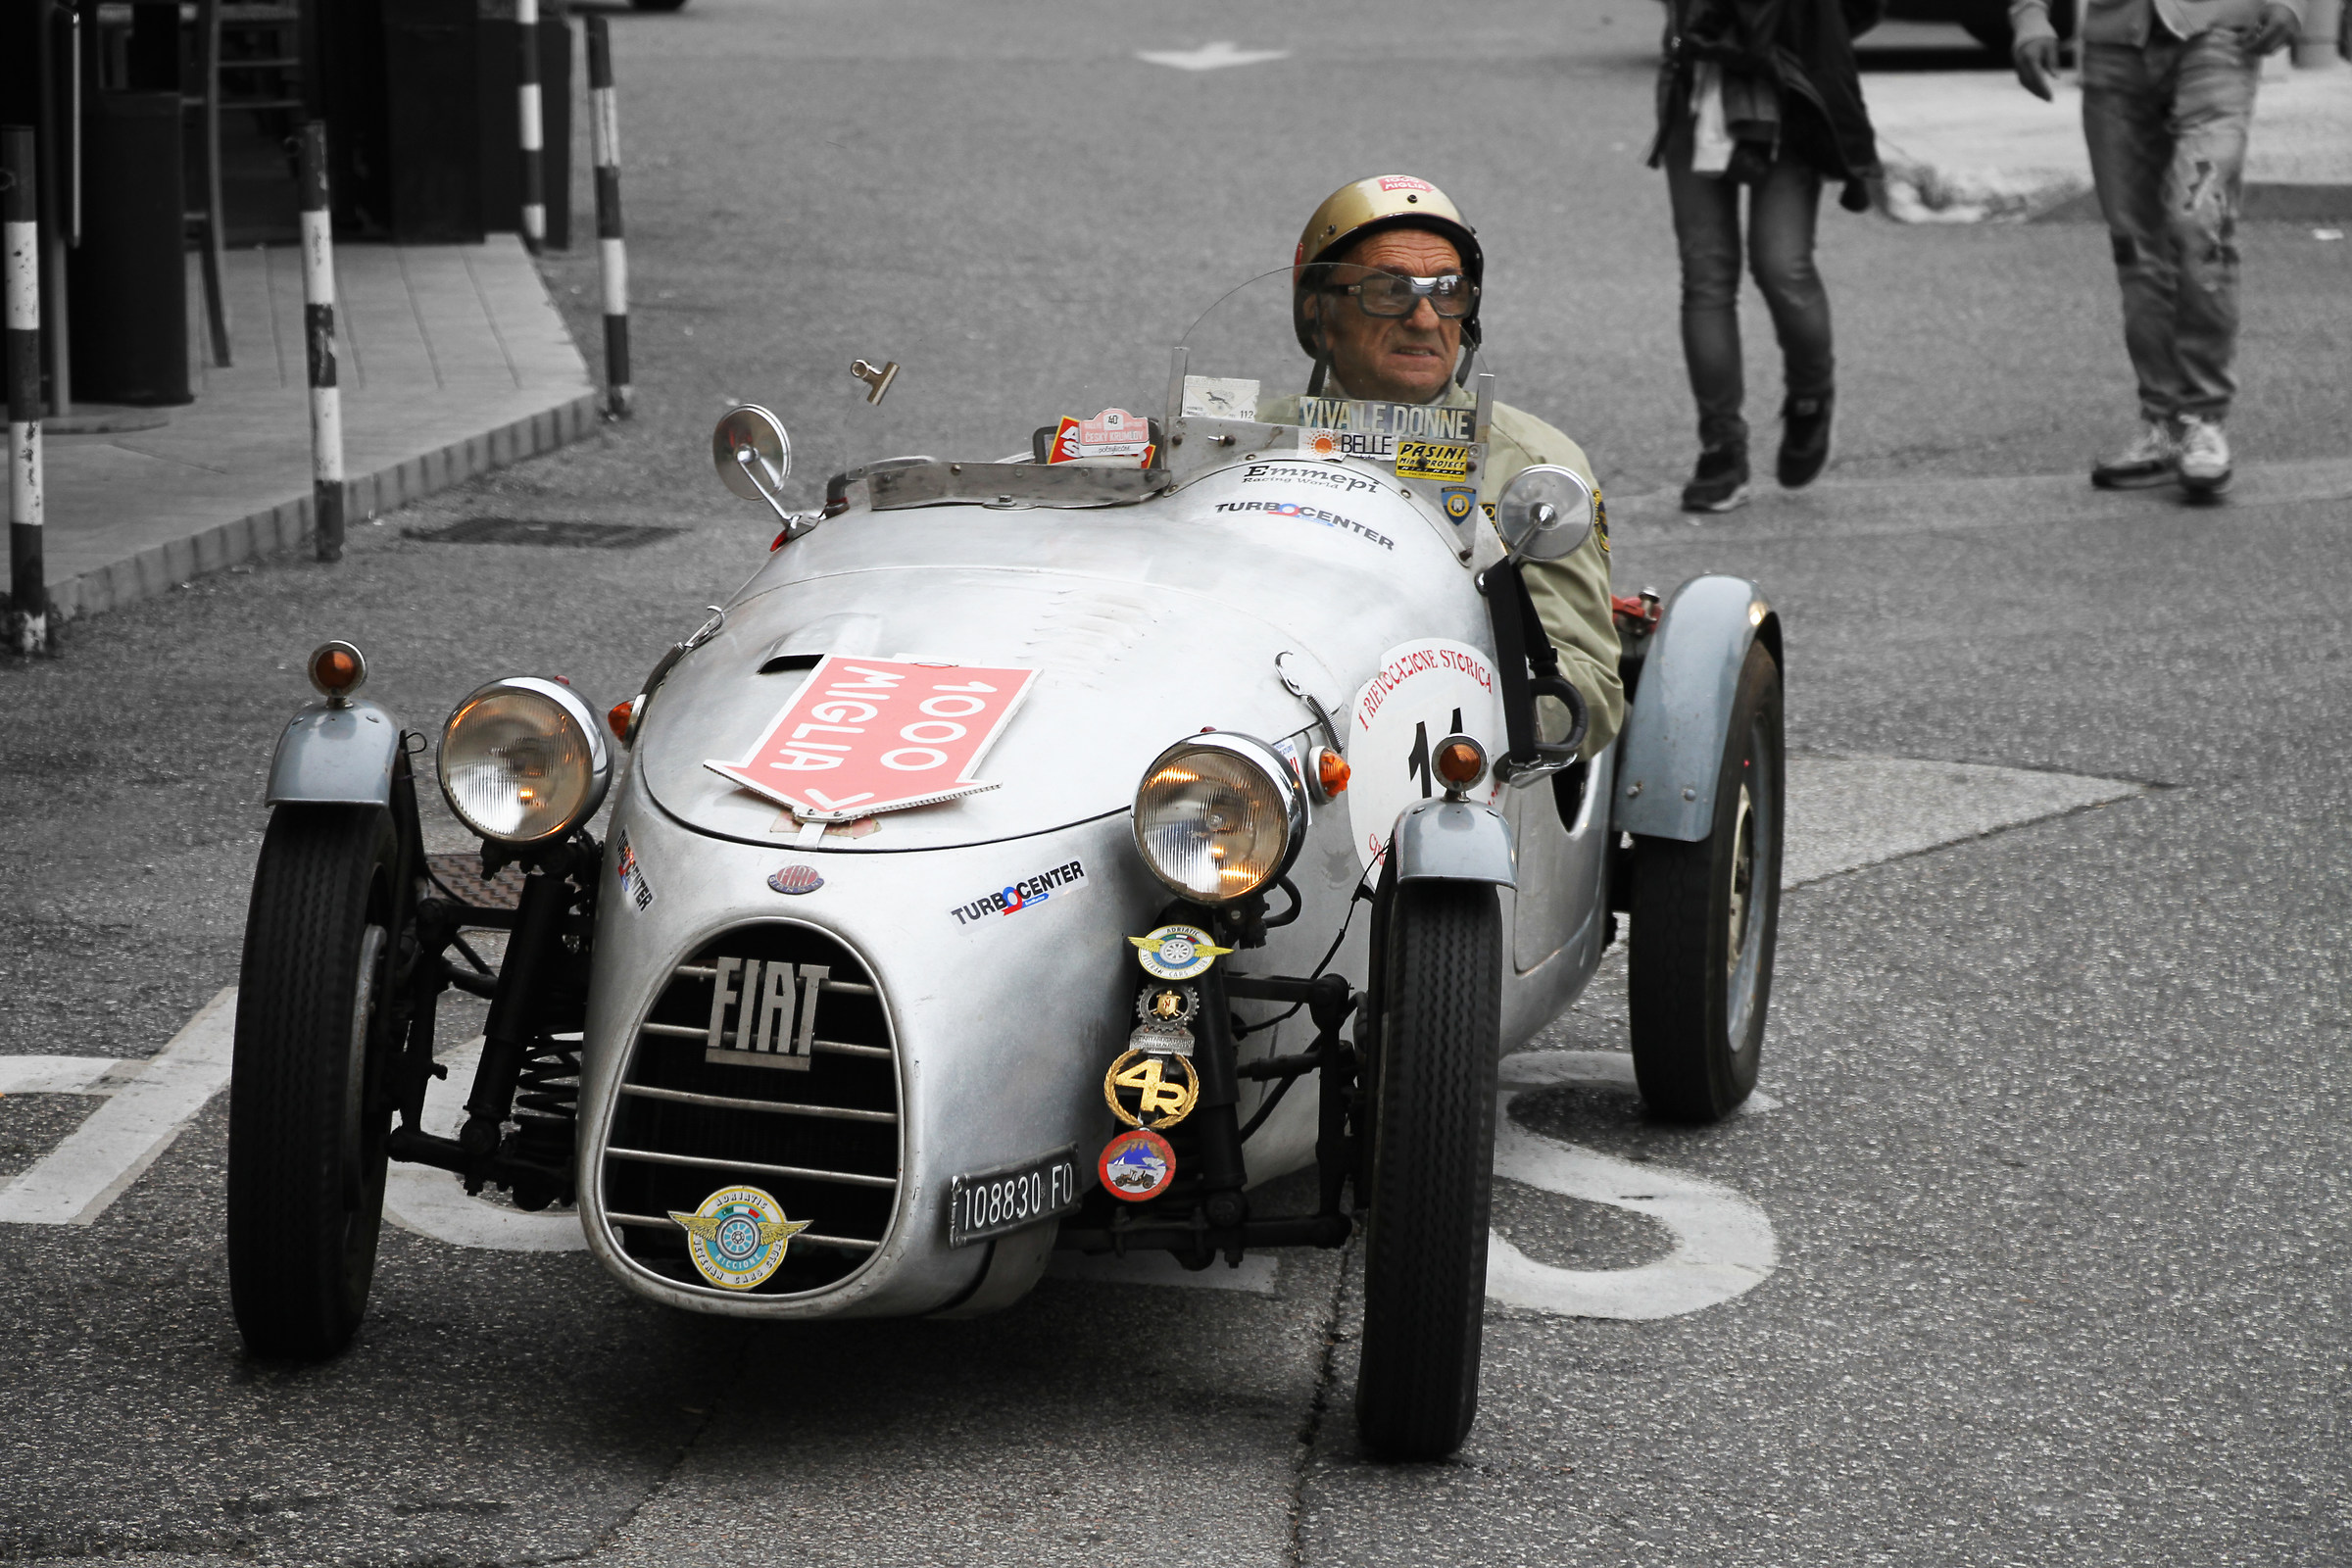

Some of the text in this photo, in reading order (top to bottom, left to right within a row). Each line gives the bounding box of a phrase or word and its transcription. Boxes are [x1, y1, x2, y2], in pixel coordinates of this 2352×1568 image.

[1384, 181, 1427, 190] MIGLIA
[1107, 415, 1118, 425] 40
[1240, 410, 1254, 419] 112
[1301, 399, 1470, 439] VIVA LE DONNE
[1109, 429, 1144, 442] KRUMLOV
[1341, 433, 1393, 456] BELLE
[1399, 444, 1466, 461] PASINI
[1243, 465, 1379, 494] Emmepi
[1298, 477, 1339, 489] World
[1215, 501, 1395, 551] TURBOCENTER
[1363, 650, 1439, 719] RIEVOCAZIONE
[1440, 649, 1493, 695] STORICA
[769, 665, 906, 771] MIGLIA
[880, 680, 998, 771] 1000
[779, 865, 815, 887] FIAT
[951, 859, 1085, 925] TURBOCENTER
[1166, 927, 1200, 937] ADRIATIC
[1193, 958, 1209, 972] CLUB
[708, 956, 831, 1056] FIAT
[716, 1192, 769, 1210] ADRIATIC
[965, 1171, 1041, 1231] 108830
[715, 1252, 761, 1270] RICCIONE
[735, 1270, 763, 1285] CARS
[766, 1243, 782, 1269] CLUB
